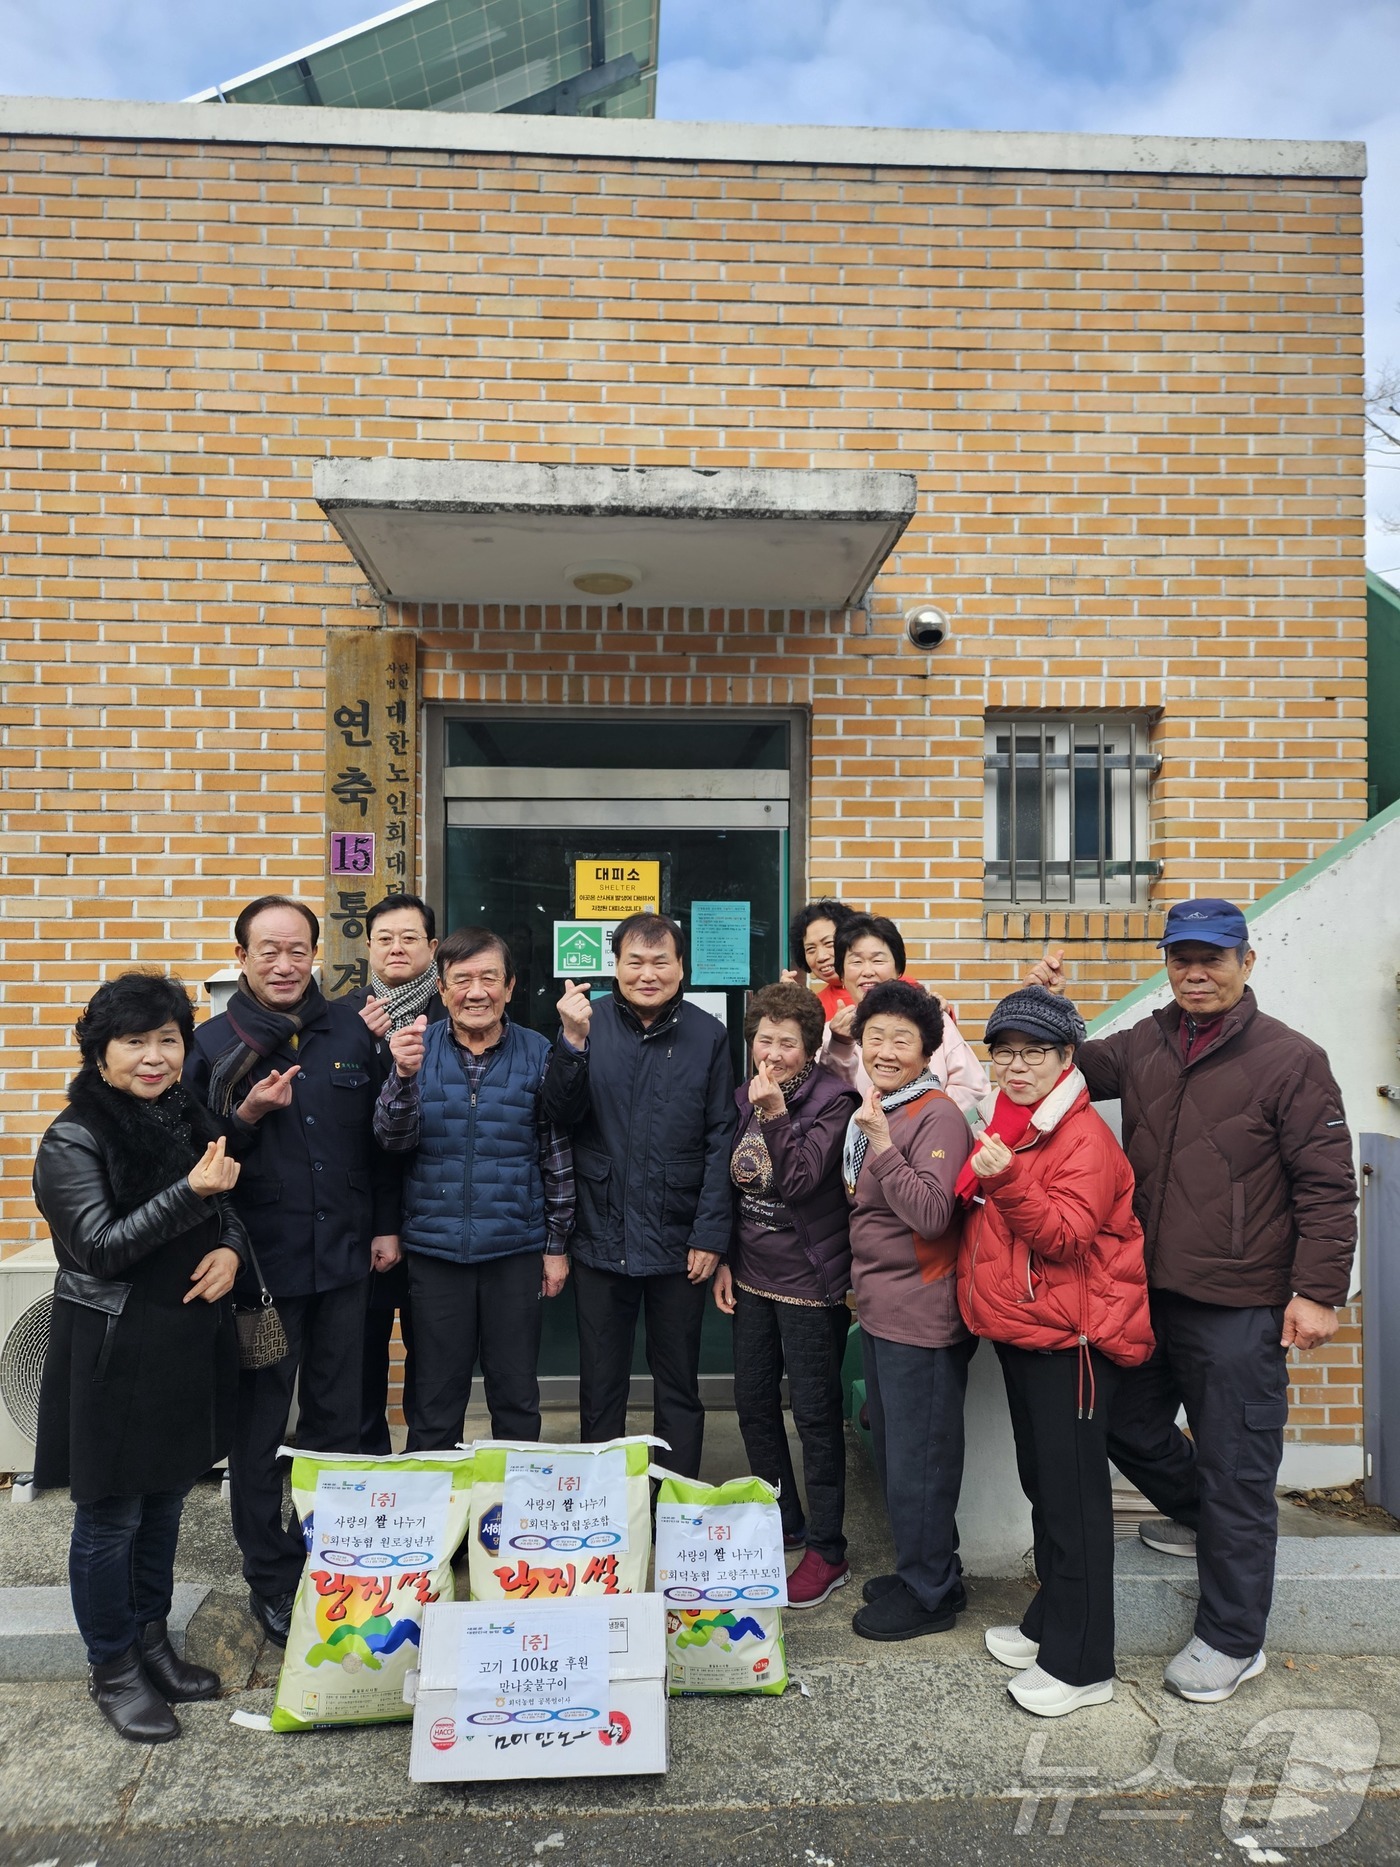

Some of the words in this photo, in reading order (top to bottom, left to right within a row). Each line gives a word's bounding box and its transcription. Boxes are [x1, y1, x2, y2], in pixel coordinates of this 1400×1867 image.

[334, 834, 371, 872] 15
[595, 867, 640, 881] 대피소
[524, 1498, 555, 1511] 사랑의
[562, 1497, 574, 1513] 쌀
[579, 1496, 606, 1511] 나누기
[334, 1515, 368, 1529] 사랑의
[374, 1514, 388, 1529] 쌀
[393, 1516, 427, 1529] 나누기
[677, 1549, 708, 1562] 사랑의
[713, 1547, 726, 1562] 쌀
[731, 1547, 763, 1561] 나누기
[479, 1659, 503, 1674] 고기
[511, 1656, 559, 1673] 100kg
[565, 1655, 589, 1671] 후원
